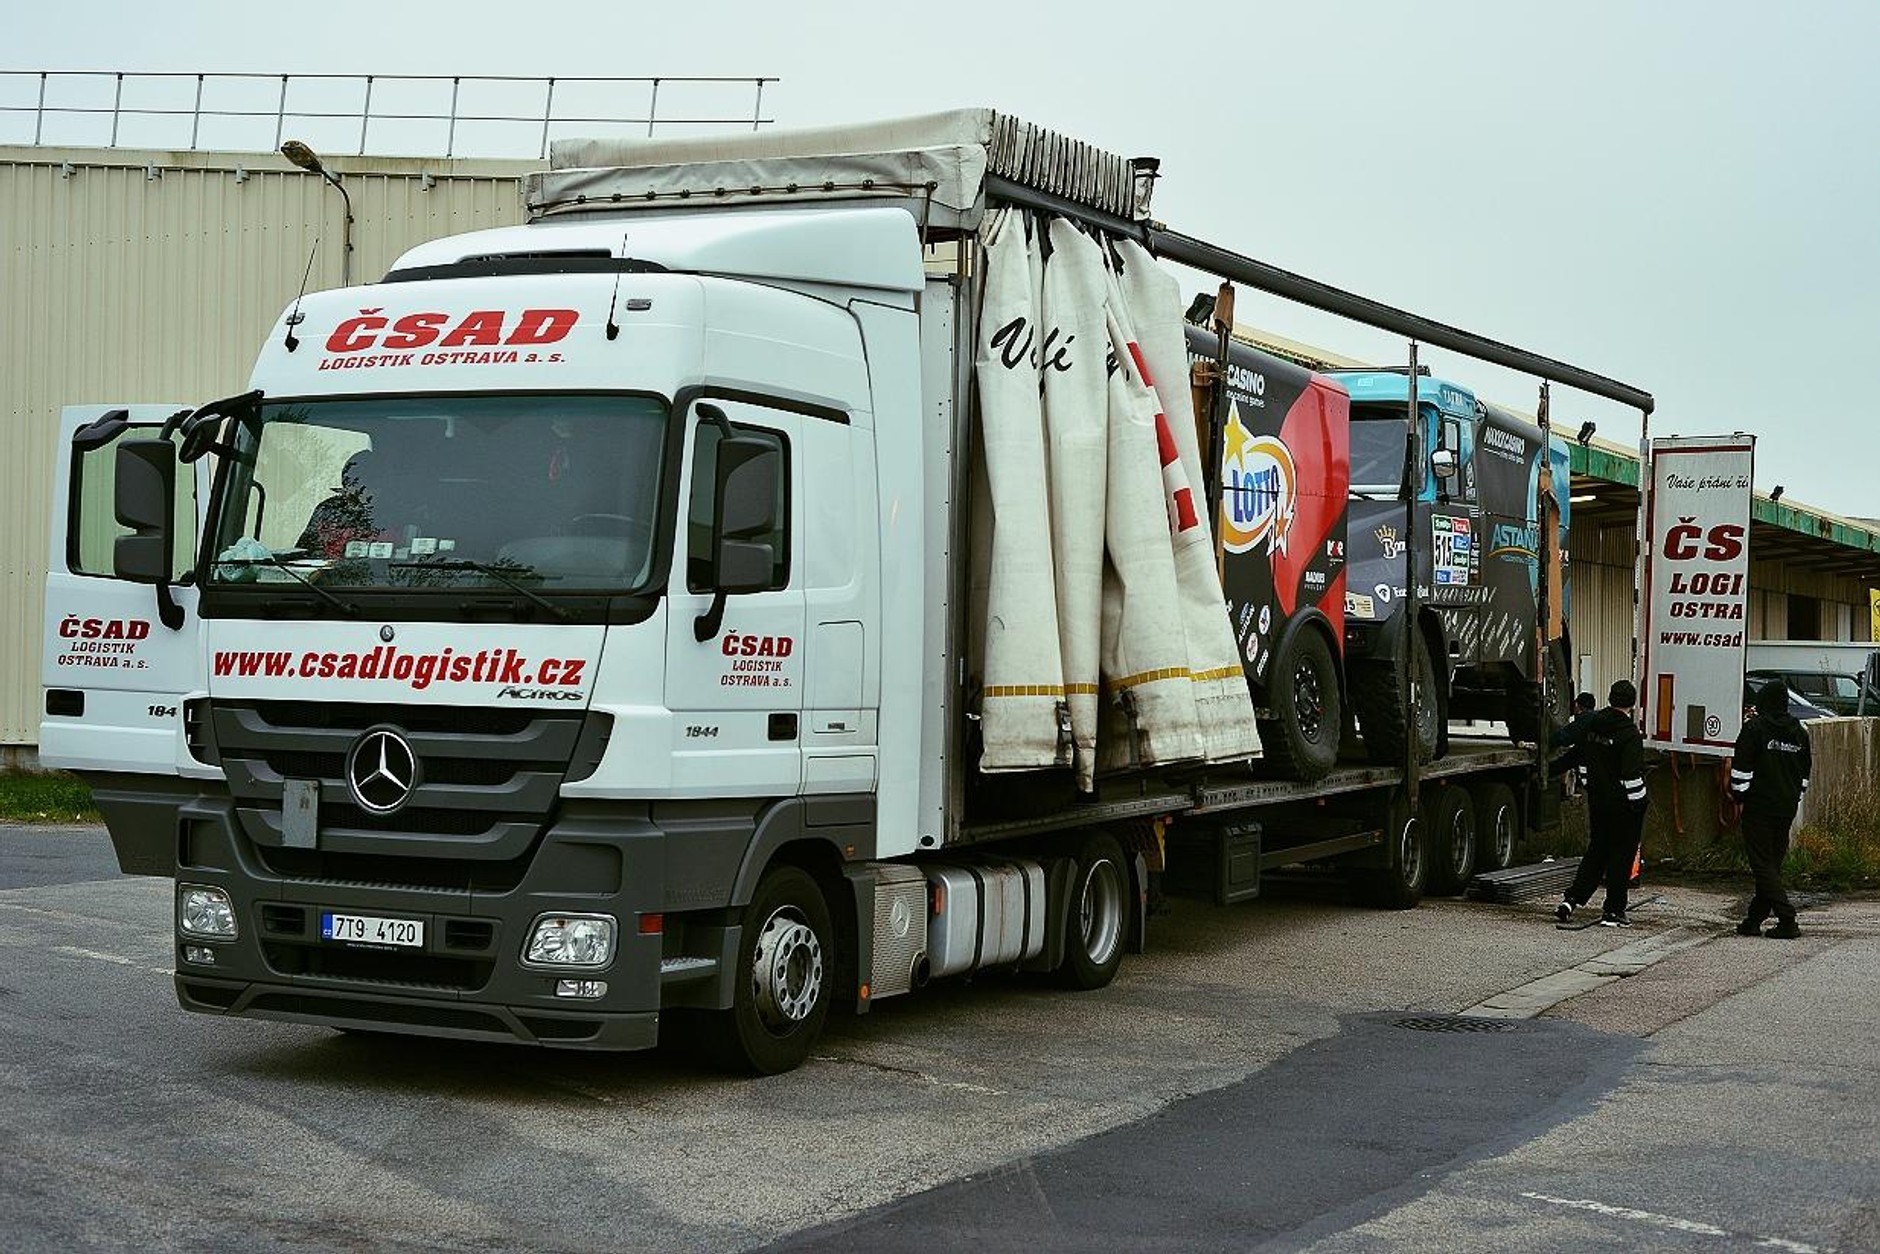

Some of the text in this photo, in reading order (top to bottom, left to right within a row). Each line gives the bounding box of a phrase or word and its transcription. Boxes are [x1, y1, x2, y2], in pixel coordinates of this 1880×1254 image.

[325, 307, 580, 353] ČSAD
[318, 354, 415, 371] LOGISTIK
[420, 351, 518, 366] OSTRAVA
[1227, 364, 1265, 396] CASINO
[1232, 464, 1279, 523] LOTTO
[1667, 474, 1695, 489] Vaše
[1697, 475, 1733, 493] přání
[1435, 534, 1452, 566] 515
[59, 614, 151, 640] ČSAD
[70, 642, 135, 654] LOGISTIK
[722, 629, 793, 657] ČSAD
[57, 656, 119, 668] OSTRAVA
[213, 646, 586, 690] www.csadlogistik.cz
[732, 660, 783, 672] LOGISTIK
[720, 675, 770, 687] OSTRAVA
[685, 726, 719, 737] 1844
[336, 917, 416, 943] 7T9 4120
